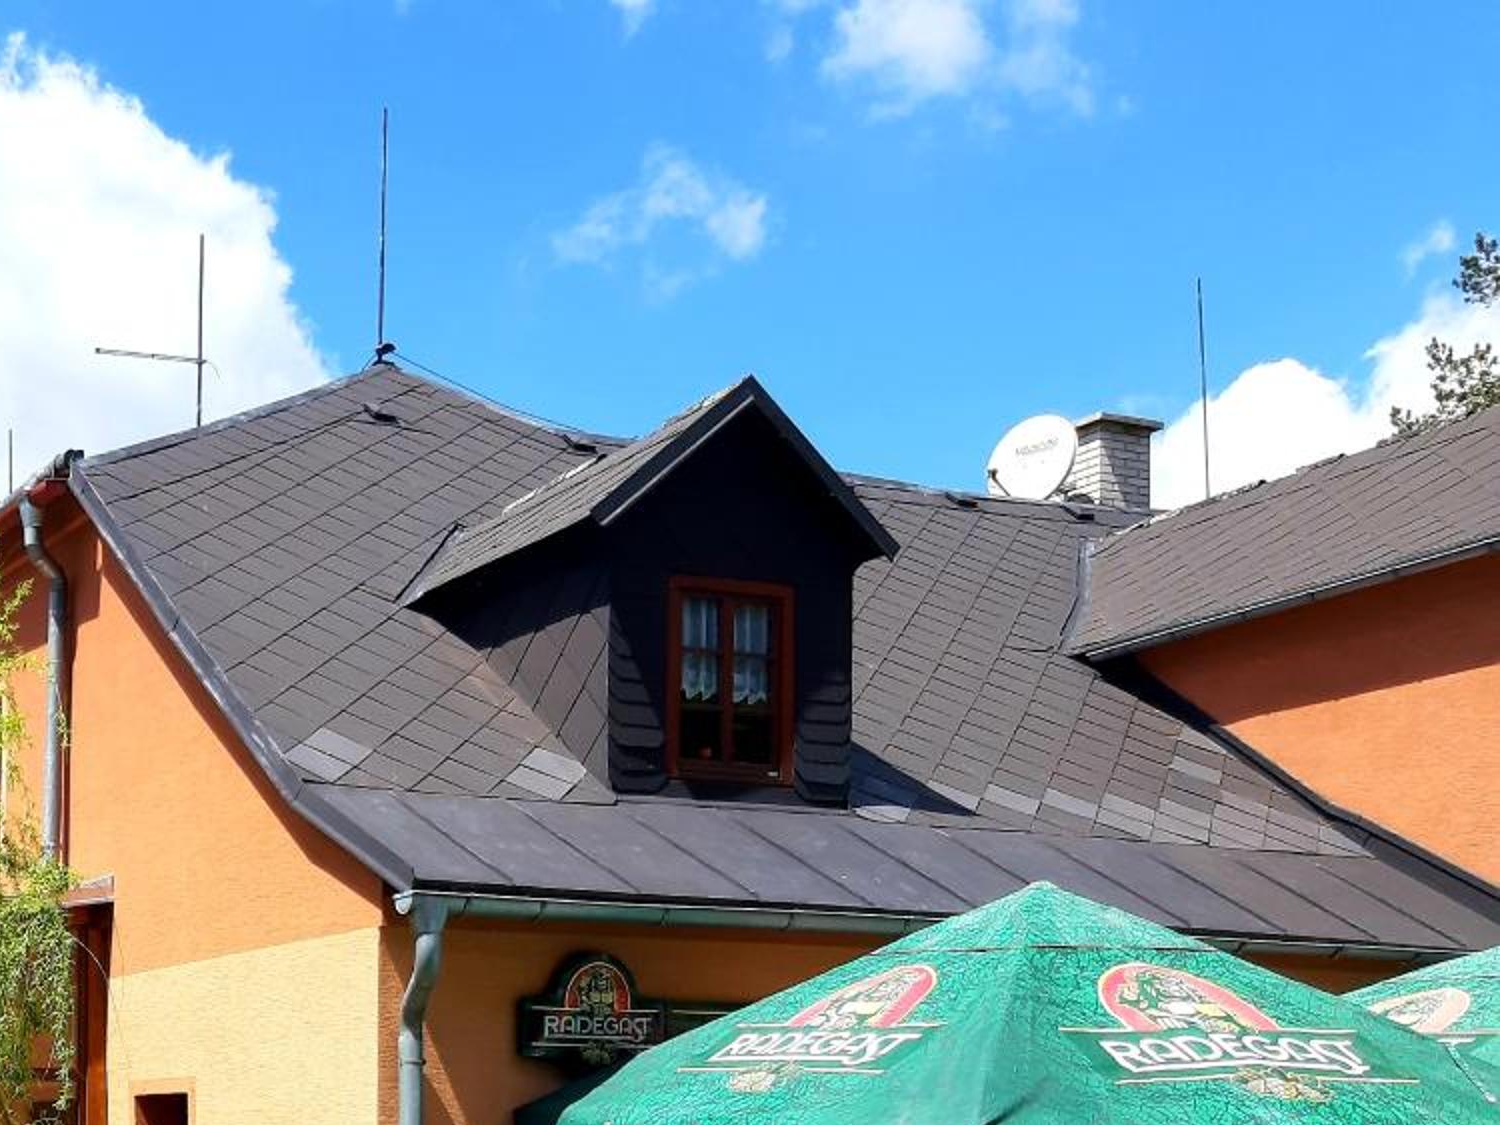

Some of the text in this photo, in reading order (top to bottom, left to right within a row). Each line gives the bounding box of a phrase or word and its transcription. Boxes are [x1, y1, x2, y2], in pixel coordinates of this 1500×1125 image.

[544, 1015, 653, 1042] RADEGAST
[707, 1033, 923, 1065] RADEGAST
[1102, 1034, 1370, 1075] RADEGAST
